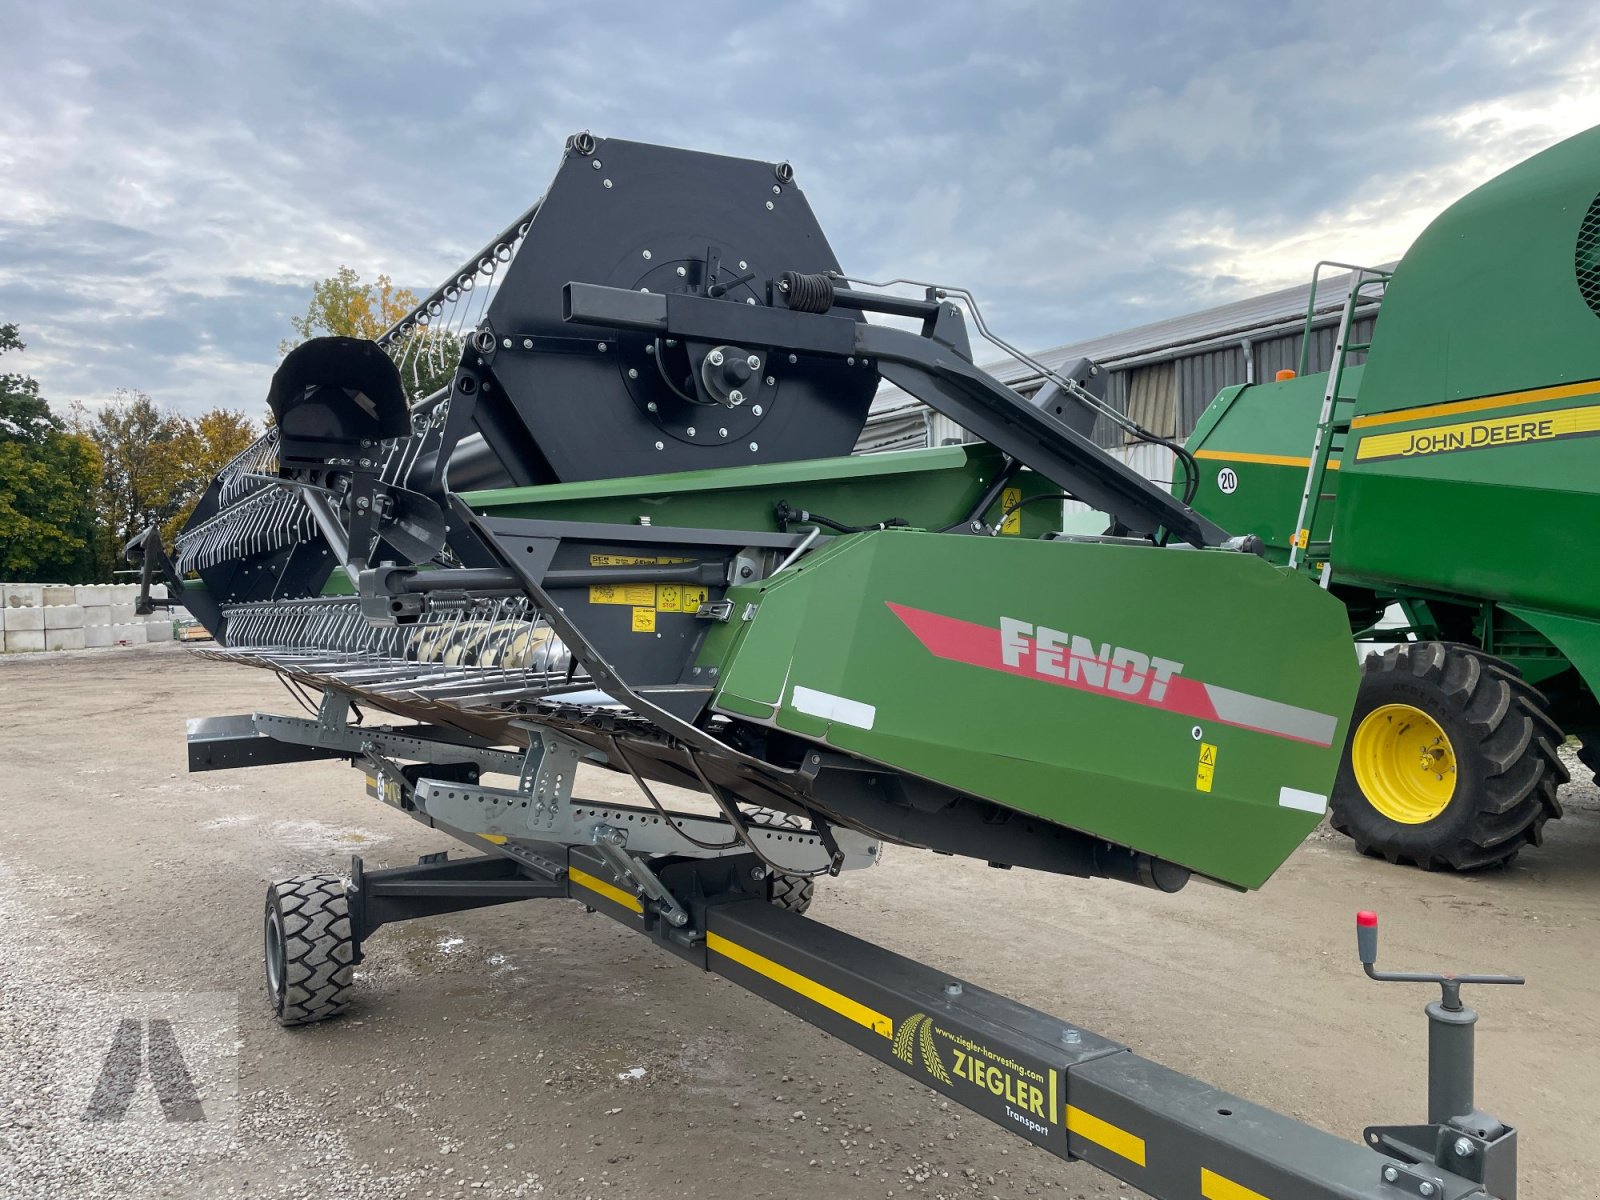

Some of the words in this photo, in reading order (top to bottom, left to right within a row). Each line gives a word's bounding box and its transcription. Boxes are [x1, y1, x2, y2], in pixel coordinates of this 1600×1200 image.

[1403, 431, 1464, 454] JOHN
[1471, 420, 1553, 445] DEERE
[1221, 472, 1235, 489] 20
[1000, 616, 1184, 702] FENDT
[934, 1026, 1044, 1083] www.ziegler-harvesting.com
[952, 1049, 1045, 1119] ZIEGLER
[1005, 1105, 1049, 1136] Transport
